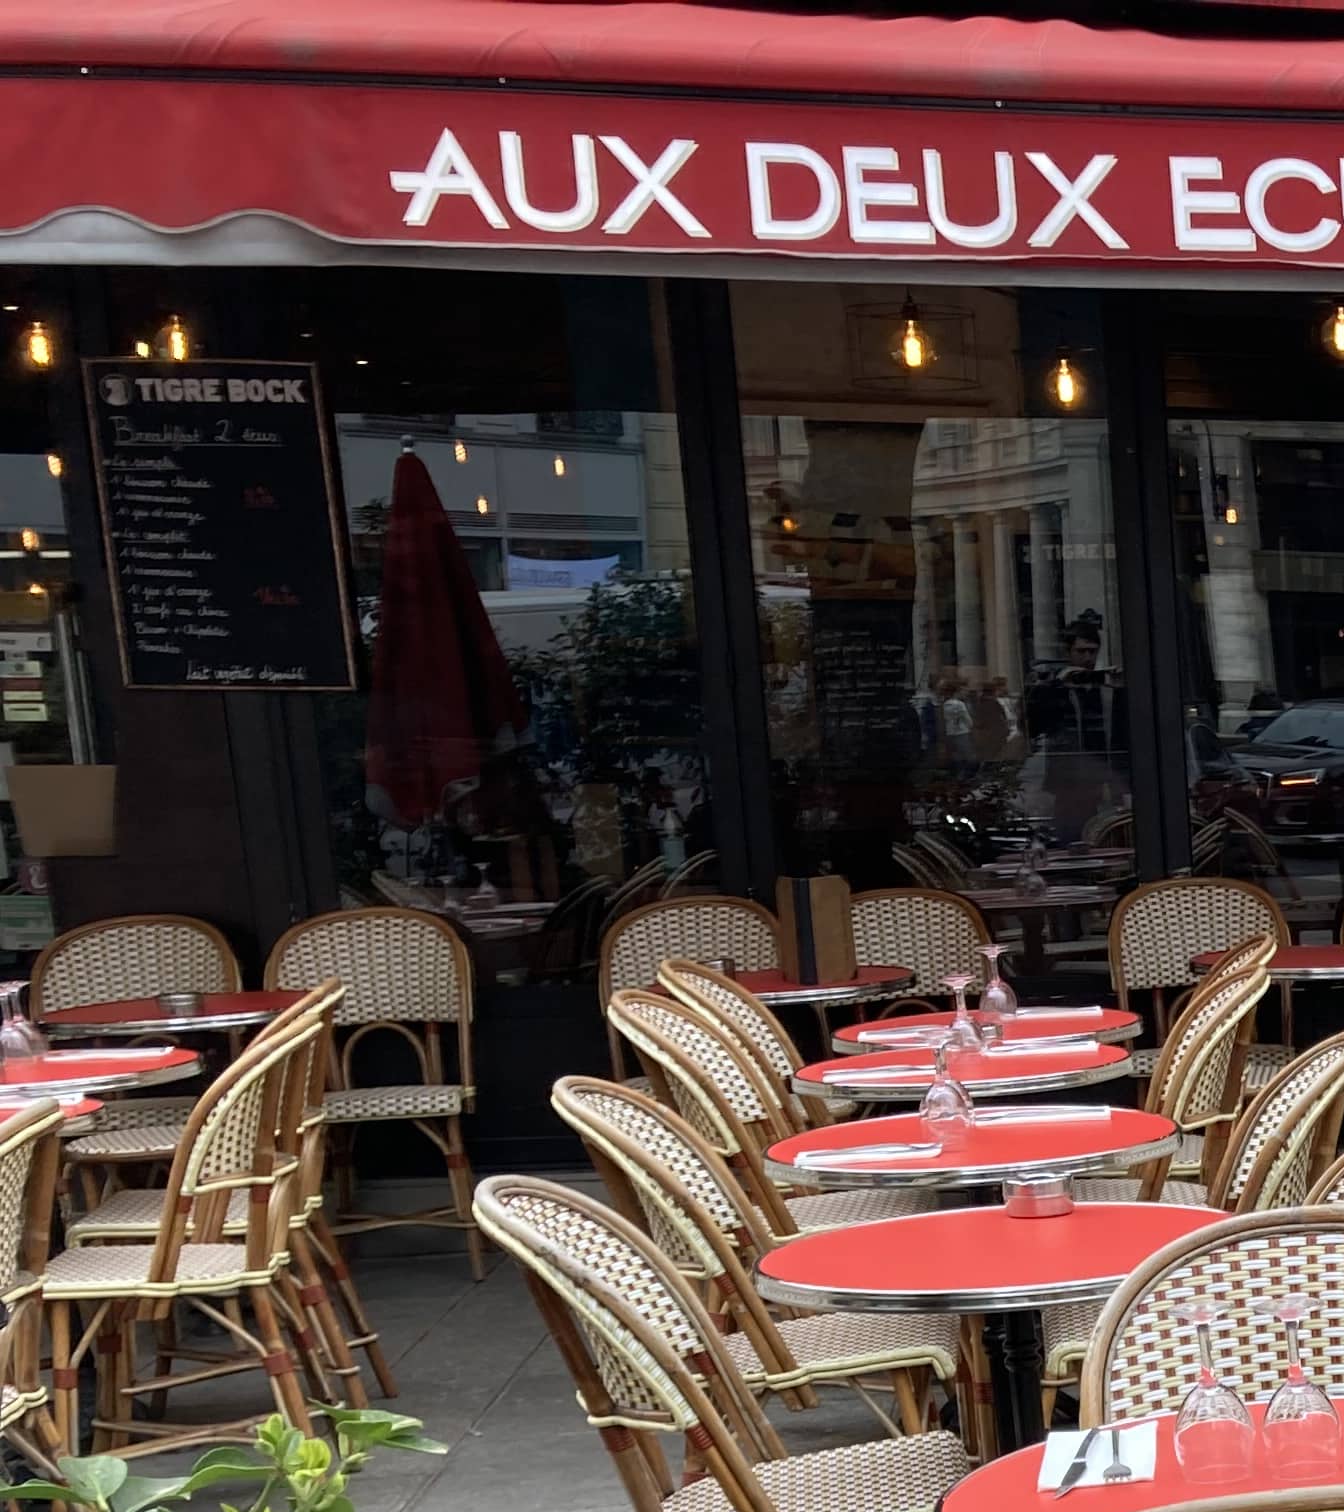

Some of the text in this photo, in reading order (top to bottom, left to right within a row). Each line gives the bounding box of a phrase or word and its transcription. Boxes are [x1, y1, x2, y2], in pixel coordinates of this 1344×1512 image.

[388, 126, 713, 240] AUX
[744, 140, 1131, 251] DEUX
[134, 378, 306, 403] TIGRE BOCK
